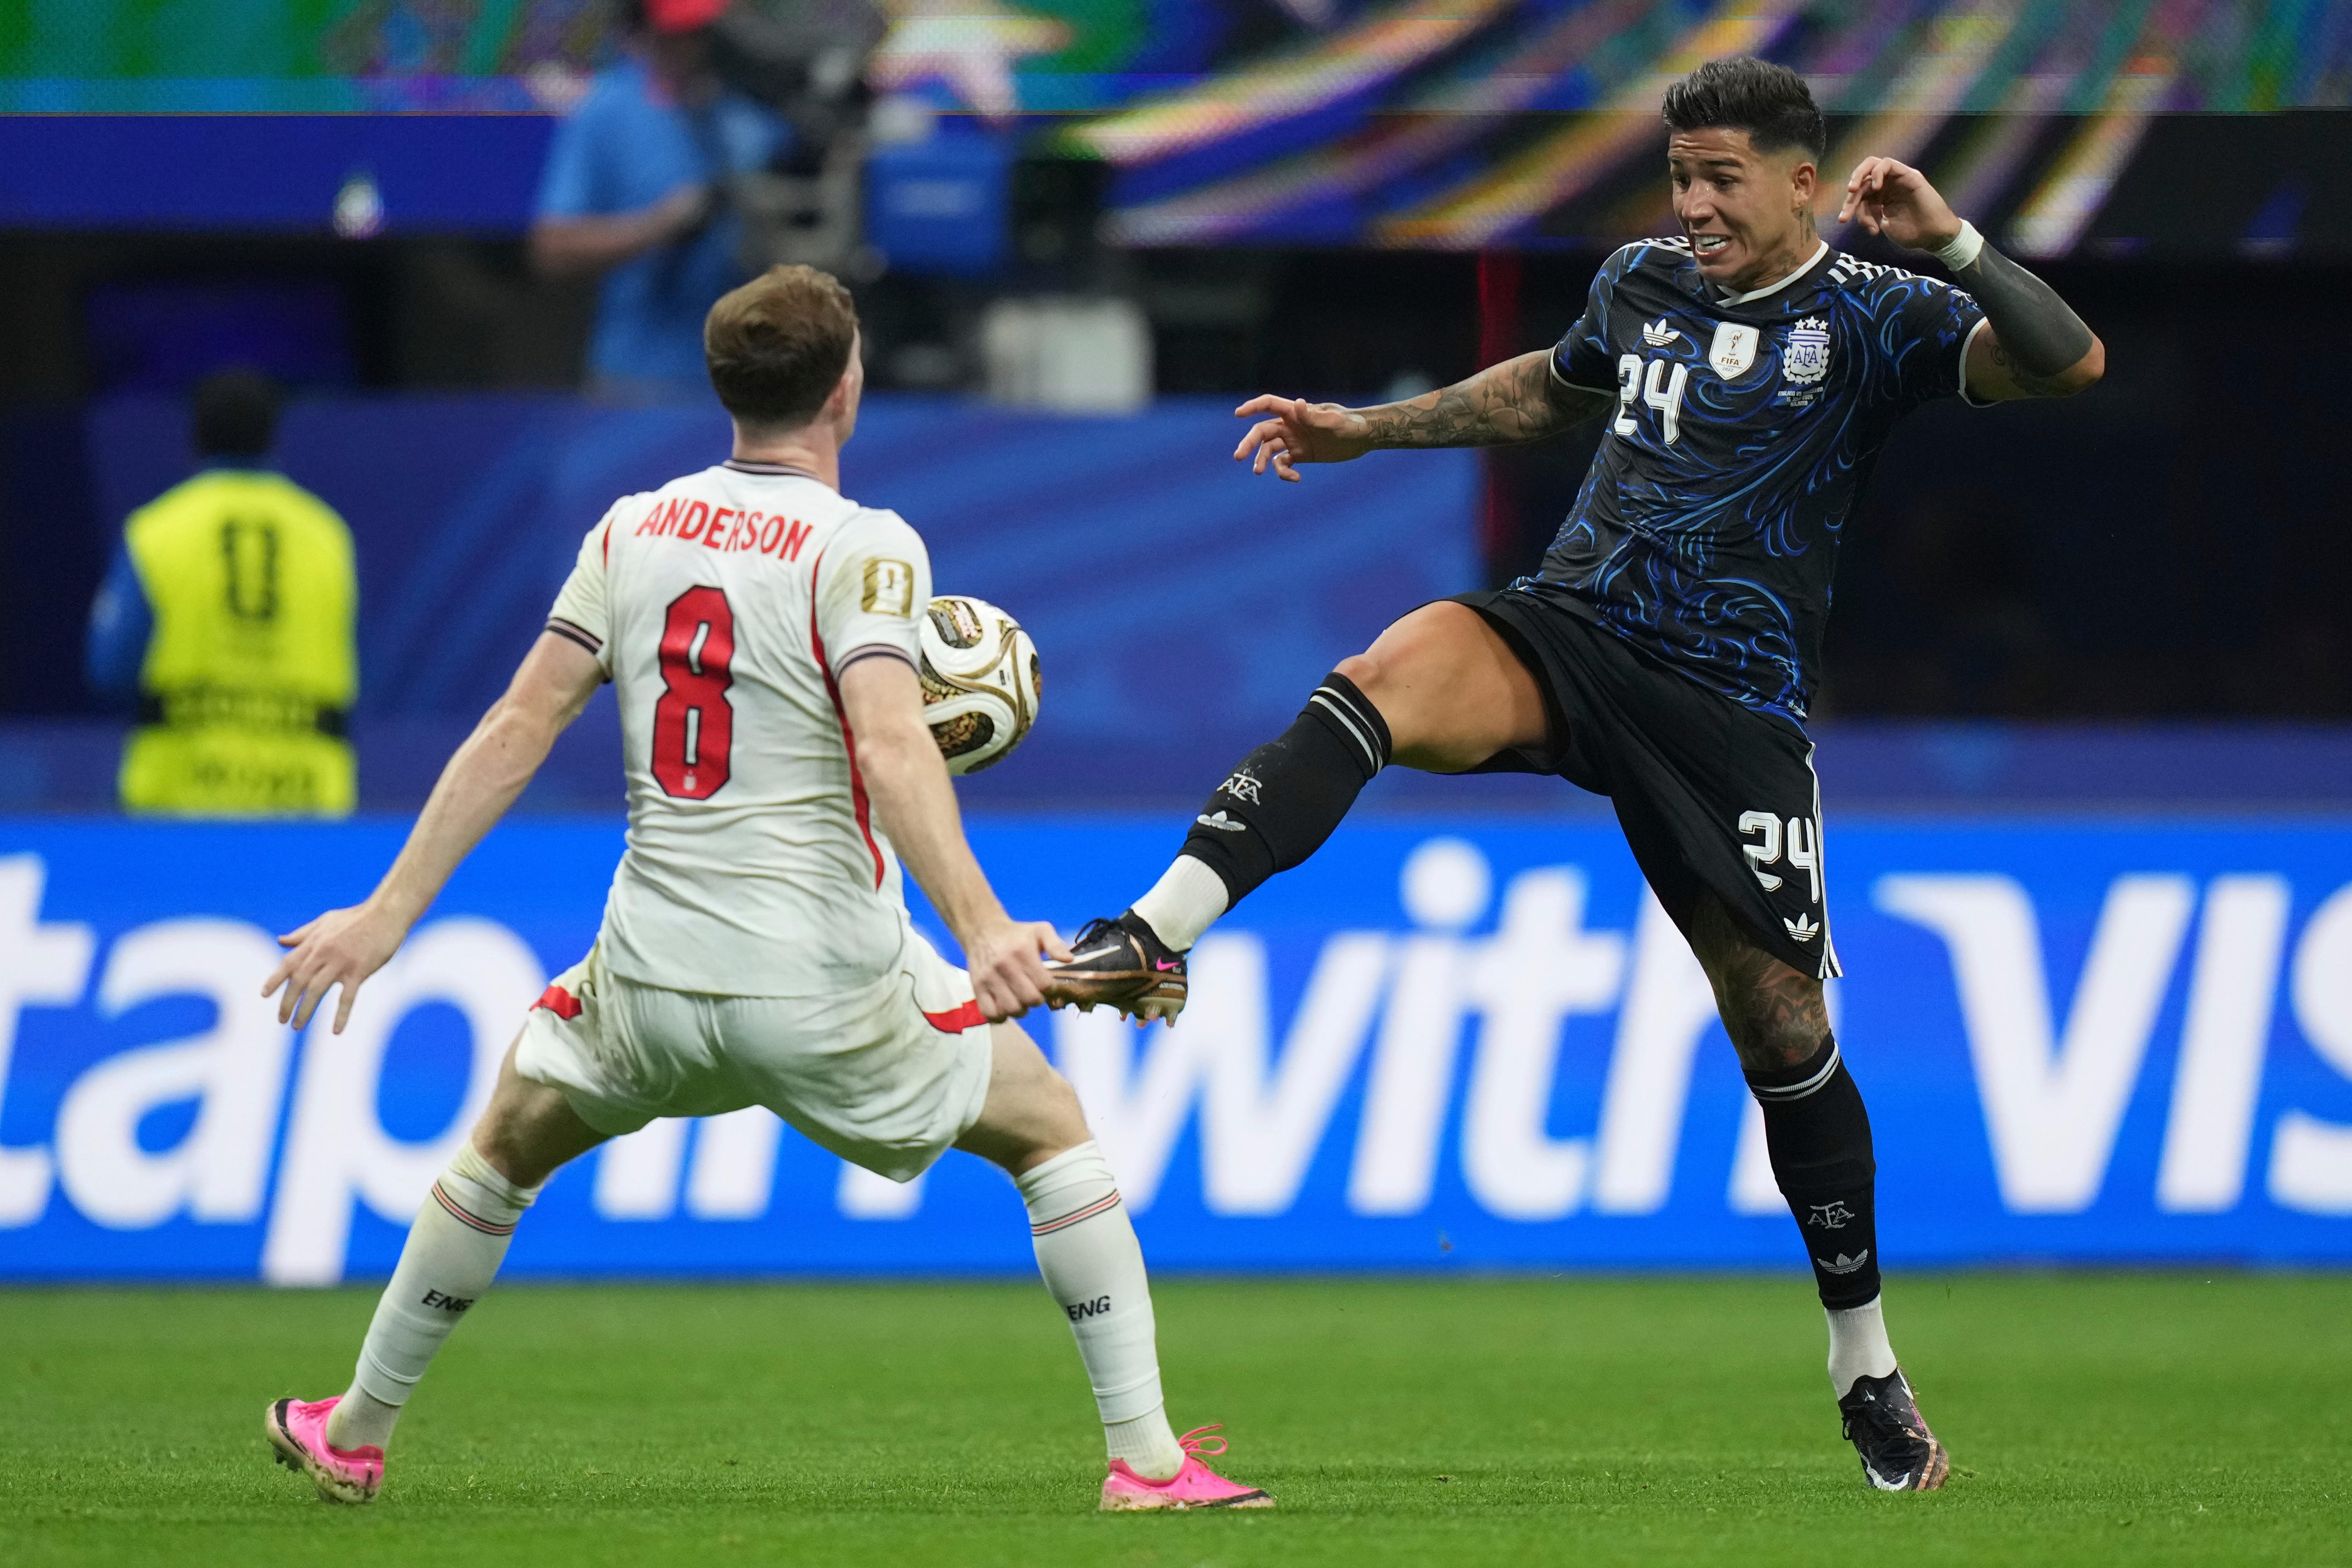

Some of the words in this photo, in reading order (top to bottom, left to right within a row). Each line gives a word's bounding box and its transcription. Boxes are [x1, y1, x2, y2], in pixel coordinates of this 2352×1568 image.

[1721, 357, 1739, 366] FIFA
[1793, 343, 1818, 368] AFA
[1614, 354, 1688, 445] 24
[636, 498, 813, 562] ANDERSON
[651, 584, 735, 800] 8
[1739, 810, 1820, 904] 24
[421, 1288, 474, 1312] ENG
[1067, 1295, 1110, 1320] ENG
